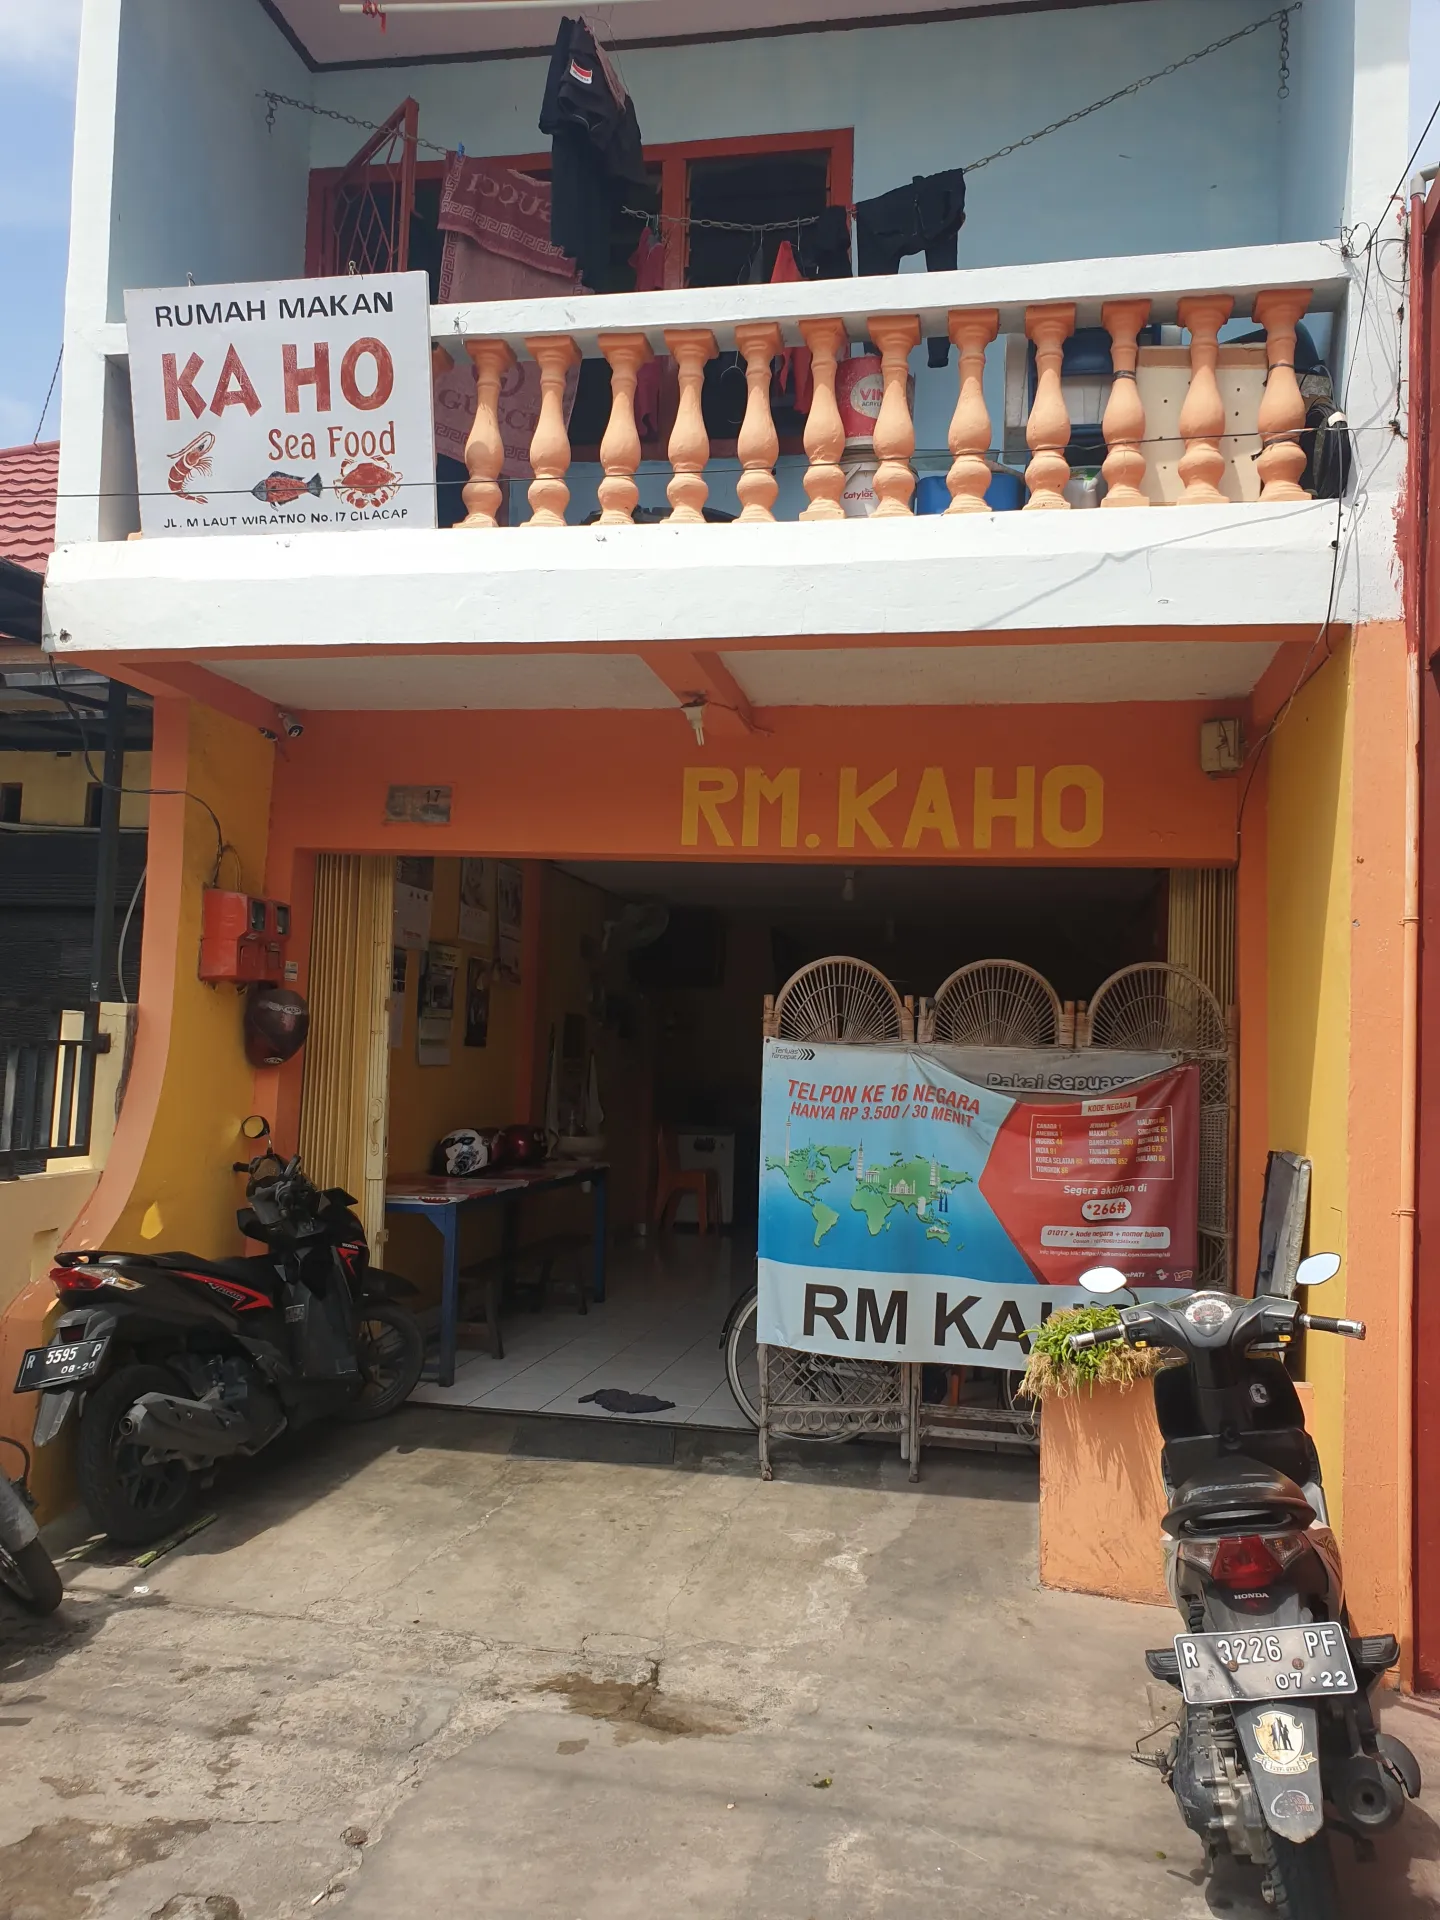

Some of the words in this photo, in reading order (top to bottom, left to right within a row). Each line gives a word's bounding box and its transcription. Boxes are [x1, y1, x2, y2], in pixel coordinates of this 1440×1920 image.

[155, 300, 265, 327] RUMAH
[279, 291, 394, 320] MAKAN
[268, 428, 316, 461] Sea
[327, 421, 396, 458] Food
[203, 516, 238, 527] LAUT
[242, 512, 306, 525] WIRATNO
[350, 508, 408, 522] CILACAP
[987, 1072, 1044, 1089] Pakai
[788, 1079, 858, 1104] TELPON
[861, 1084, 886, 1103] KE
[891, 1083, 908, 1102] 16
[912, 1084, 980, 1115] NEGARA
[1087, 1103, 1105, 1112] KODE
[1106, 1101, 1131, 1111] NEGARA
[790, 1101, 836, 1120] HANYA
[840, 1106, 859, 1121] RP
[861, 1104, 901, 1120] 3.500
[902, 1104, 910, 1119] /
[911, 1104, 928, 1119] 30
[931, 1106, 975, 1128] MENIT
[1063, 1185, 1098, 1196] Segera
[1100, 1183, 1135, 1195] aktifkan
[1137, 1183, 1147, 1193] di
[1092, 1231, 1114, 1239] negara
[1144, 1230, 1164, 1239] tujuan
[803, 1283, 908, 1345] RM
[26, 1354, 36, 1369] R
[45, 1346, 79, 1365] 5595
[1234, 1592, 1270, 1600] HONDA
[1183, 1641, 1199, 1669] R
[1216, 1635, 1283, 1665] 3226
[1302, 1629, 1337, 1658] PF
